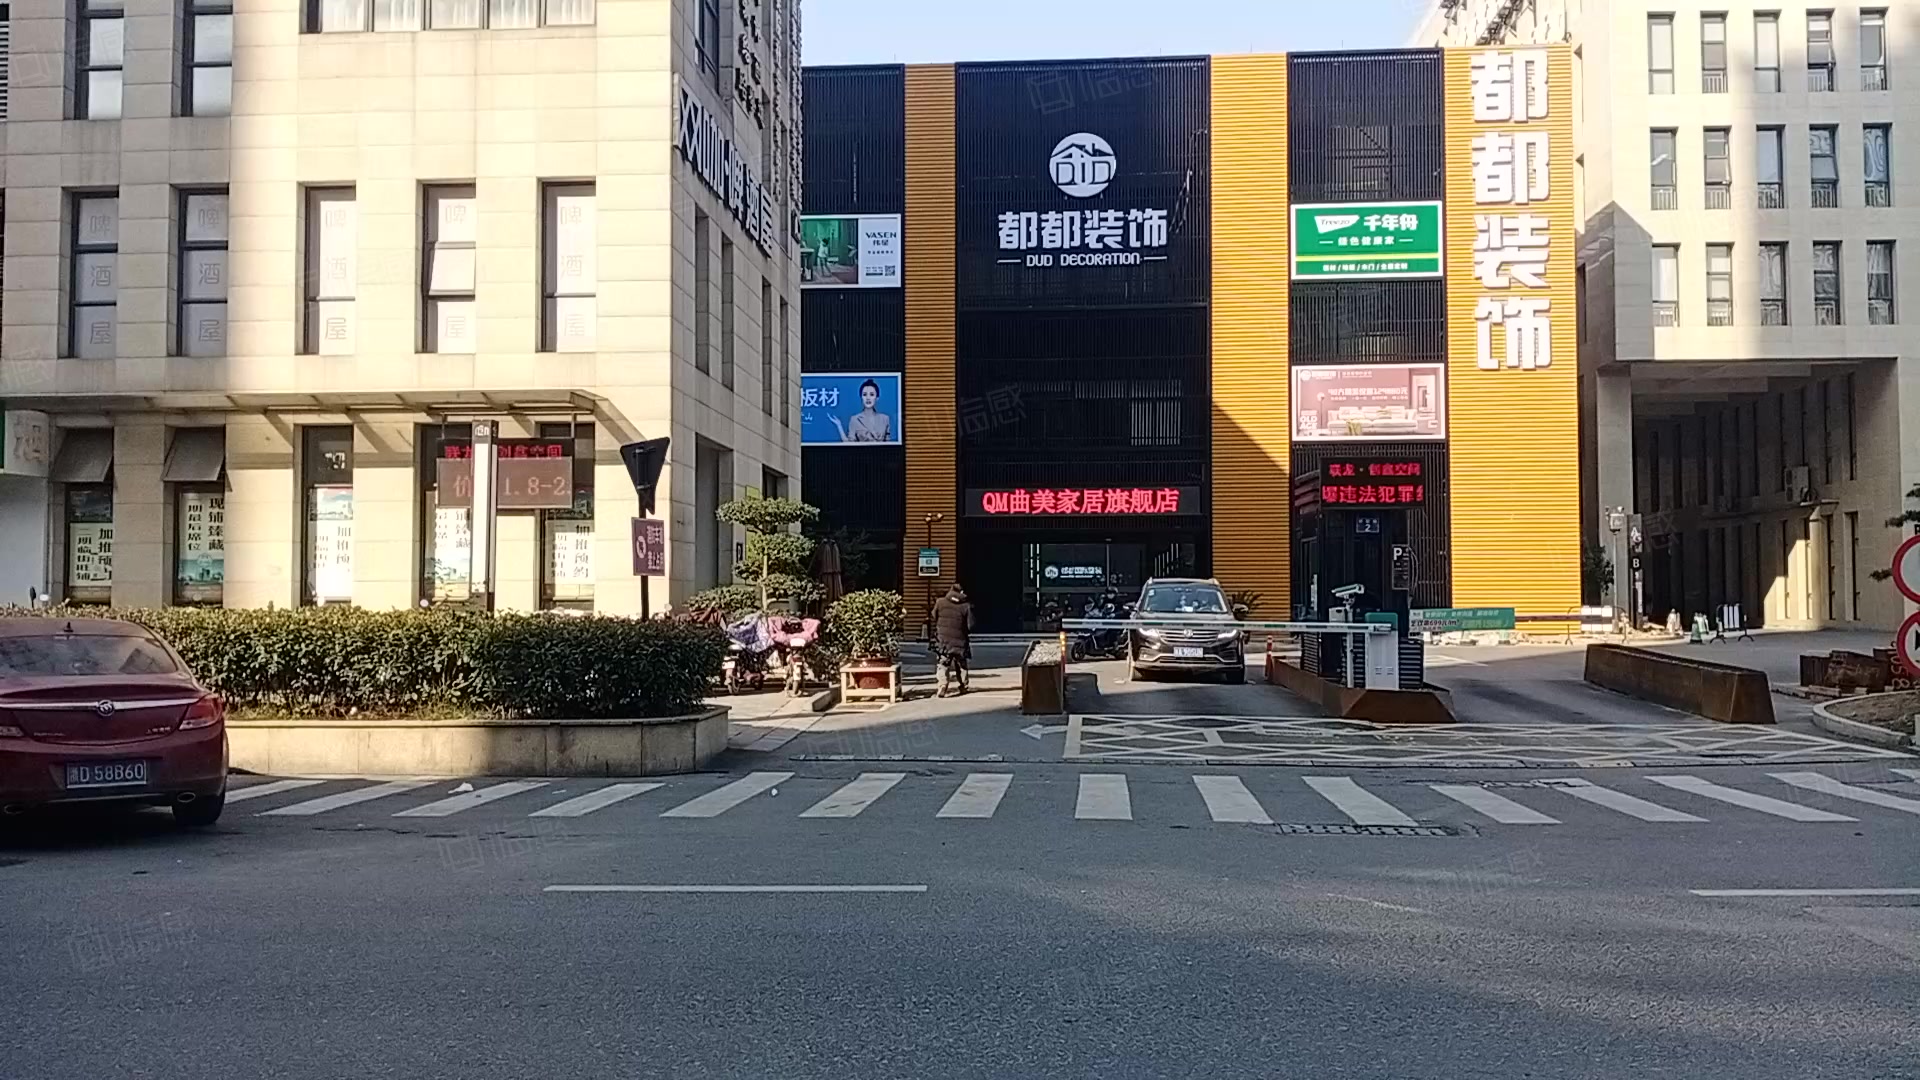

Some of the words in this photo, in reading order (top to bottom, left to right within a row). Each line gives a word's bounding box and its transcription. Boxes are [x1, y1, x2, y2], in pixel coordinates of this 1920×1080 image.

[1470, 50, 1552, 370] 都都装饰
[865, 231, 897, 239] VASEN
[997, 208, 1168, 250] 都都装饰
[1026, 254, 1053, 267] DUD
[1060, 252, 1141, 267] DECORATION
[982, 488, 1181, 515] QM曲美家居旗舰店
[1393, 547, 1402, 560] P
